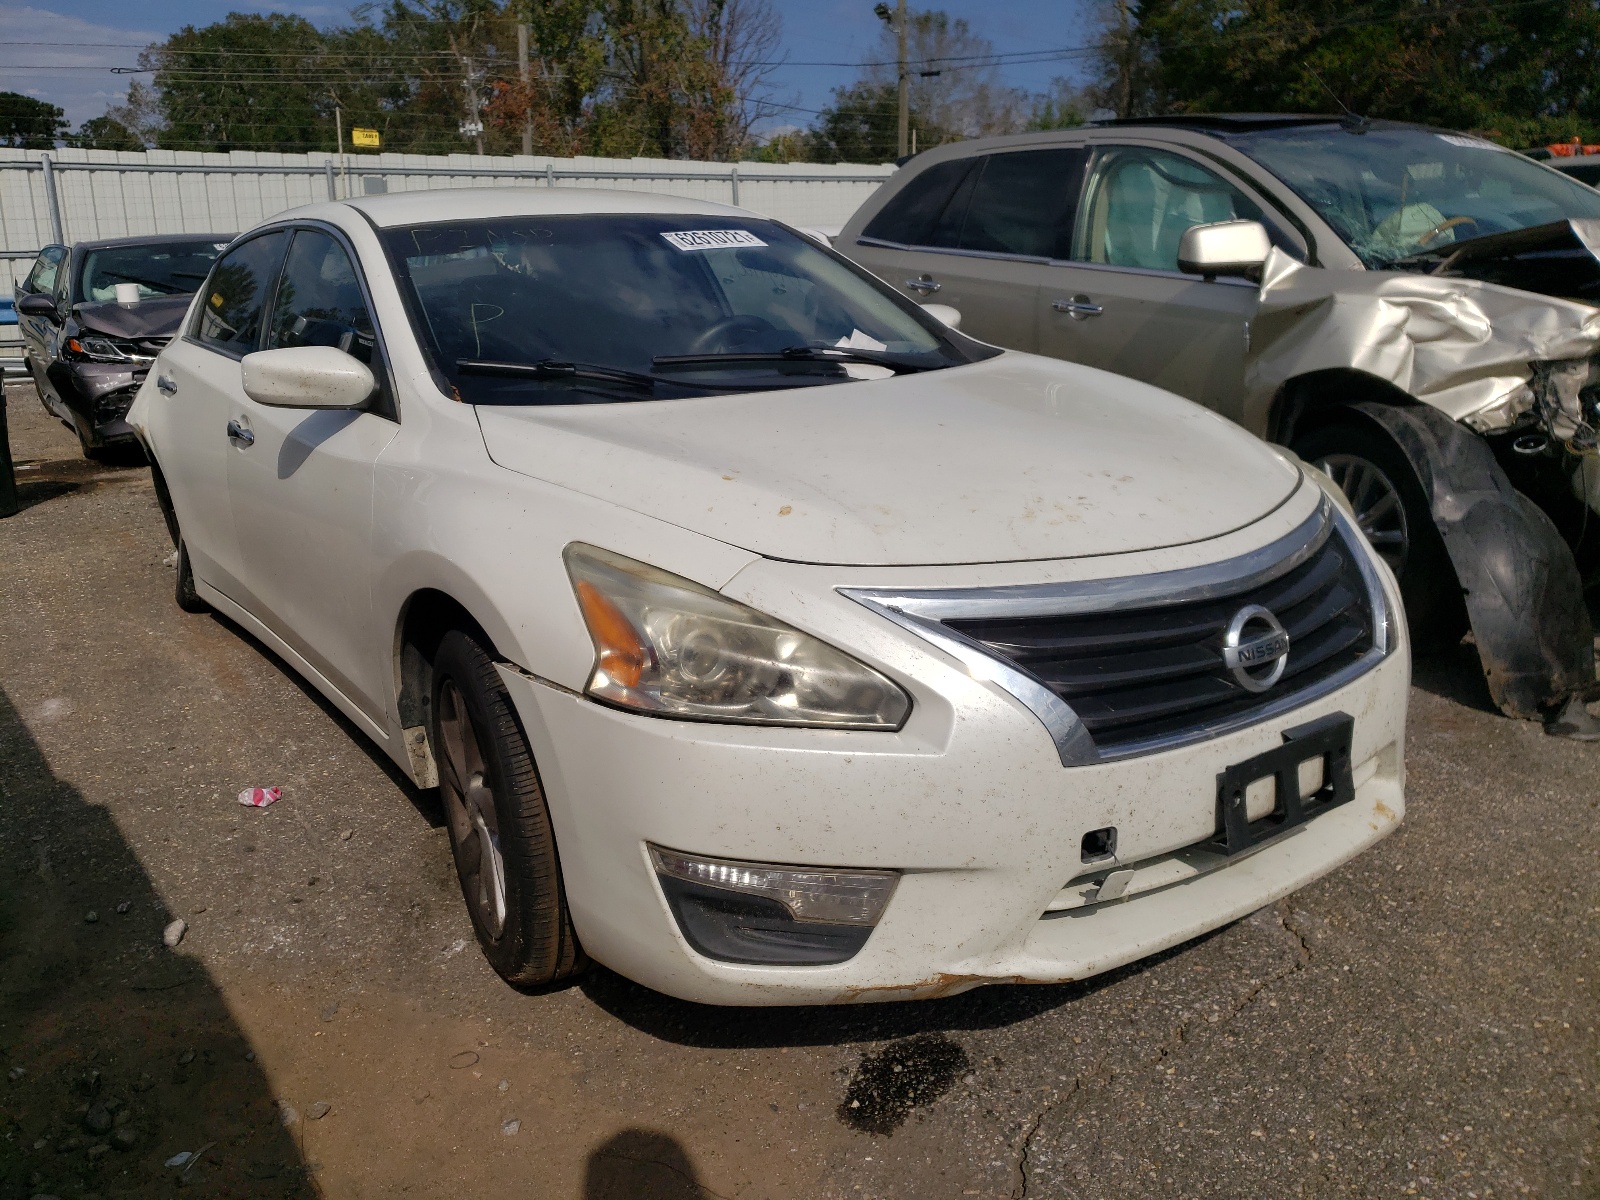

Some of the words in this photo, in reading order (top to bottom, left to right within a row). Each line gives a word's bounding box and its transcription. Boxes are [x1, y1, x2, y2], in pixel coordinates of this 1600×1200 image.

[675, 231, 750, 246] 62610721
[471, 302, 505, 358] P
[1238, 638, 1288, 663] NISSAN
